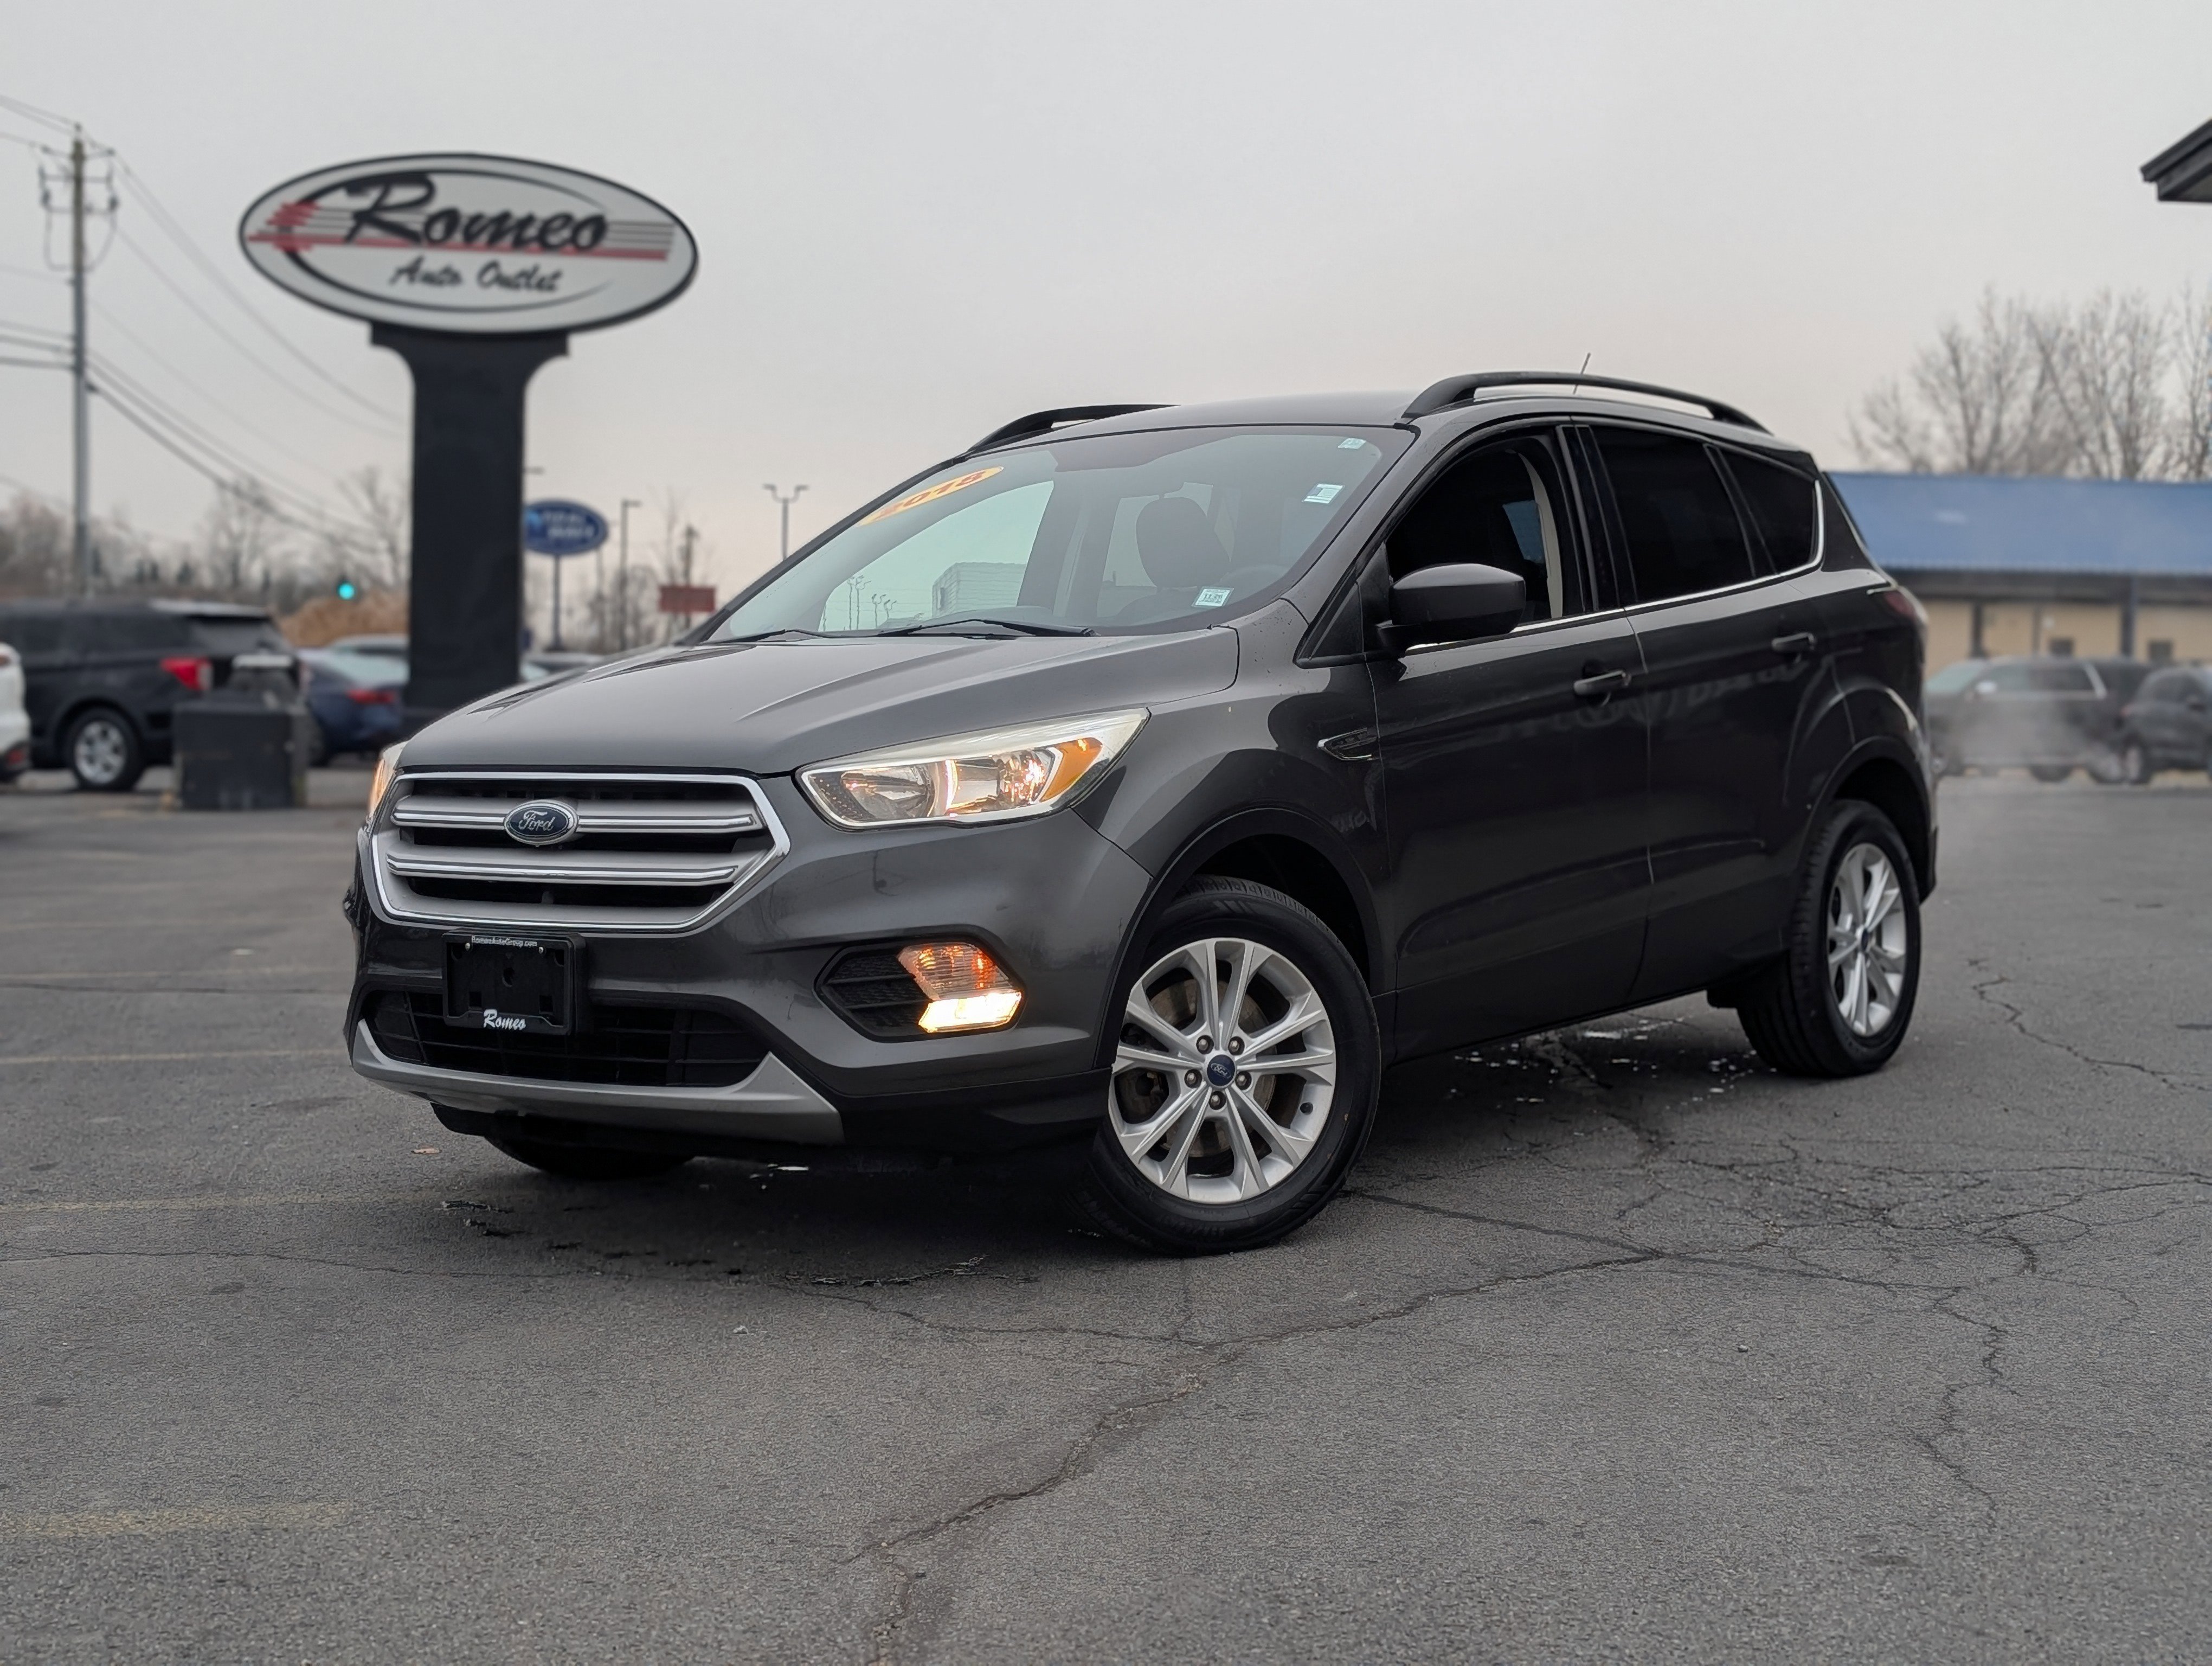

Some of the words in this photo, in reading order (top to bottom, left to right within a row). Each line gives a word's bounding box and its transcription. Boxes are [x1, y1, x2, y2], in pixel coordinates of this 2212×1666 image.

[344, 171, 607, 252] Romeo
[388, 254, 462, 286] Auto
[476, 260, 563, 293] Outlet
[518, 810, 556, 831] Ford
[483, 1009, 526, 1030] Romeo
